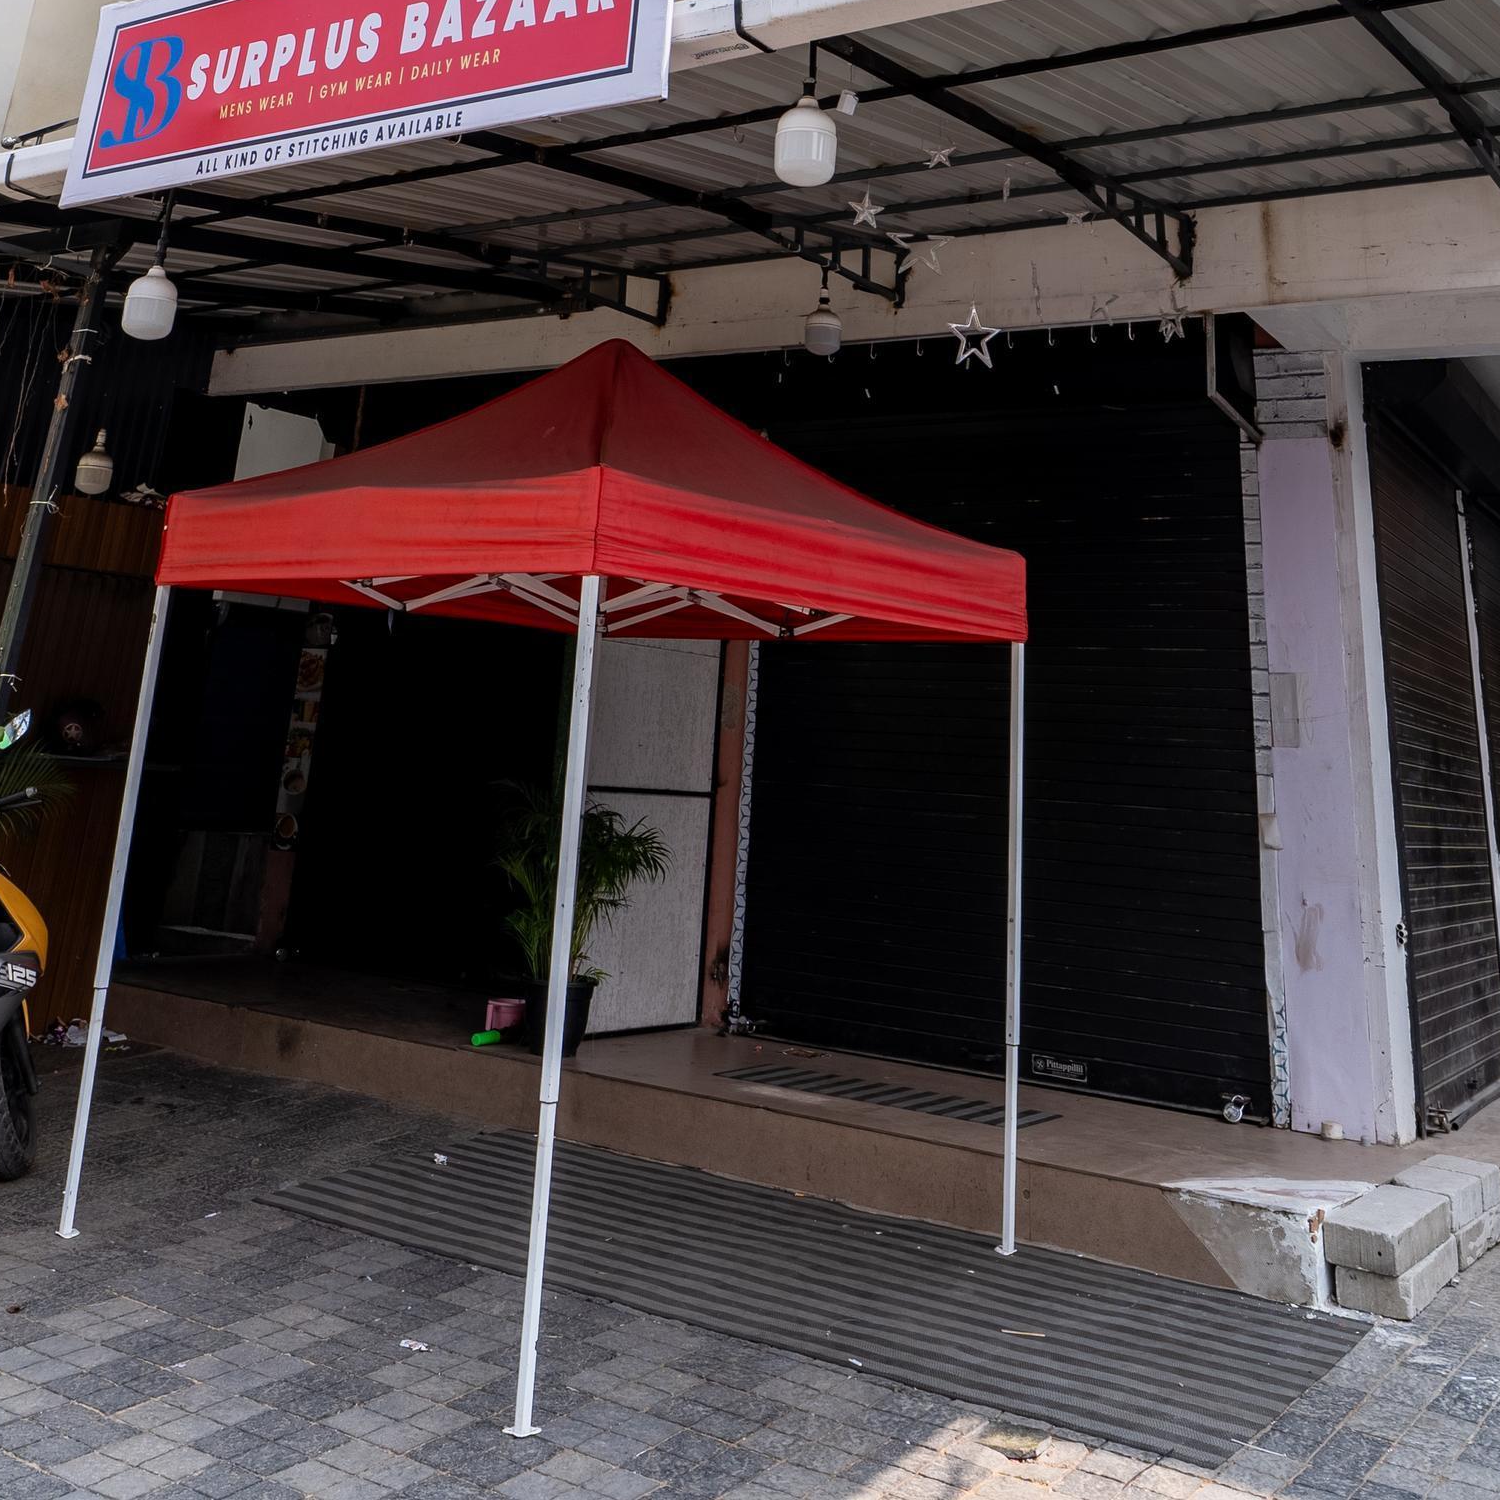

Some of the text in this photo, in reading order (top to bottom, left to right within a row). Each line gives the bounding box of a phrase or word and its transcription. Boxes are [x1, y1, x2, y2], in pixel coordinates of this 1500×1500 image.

[186, 12, 383, 100] SURPLUS
[219, 48, 501, 120] MENS WEAR GYM WEAR DAILY WEAR
[196, 111, 463, 175] ALL KIND OF STITCHING AVAILABLE
[7, 963, 37, 987] 125
